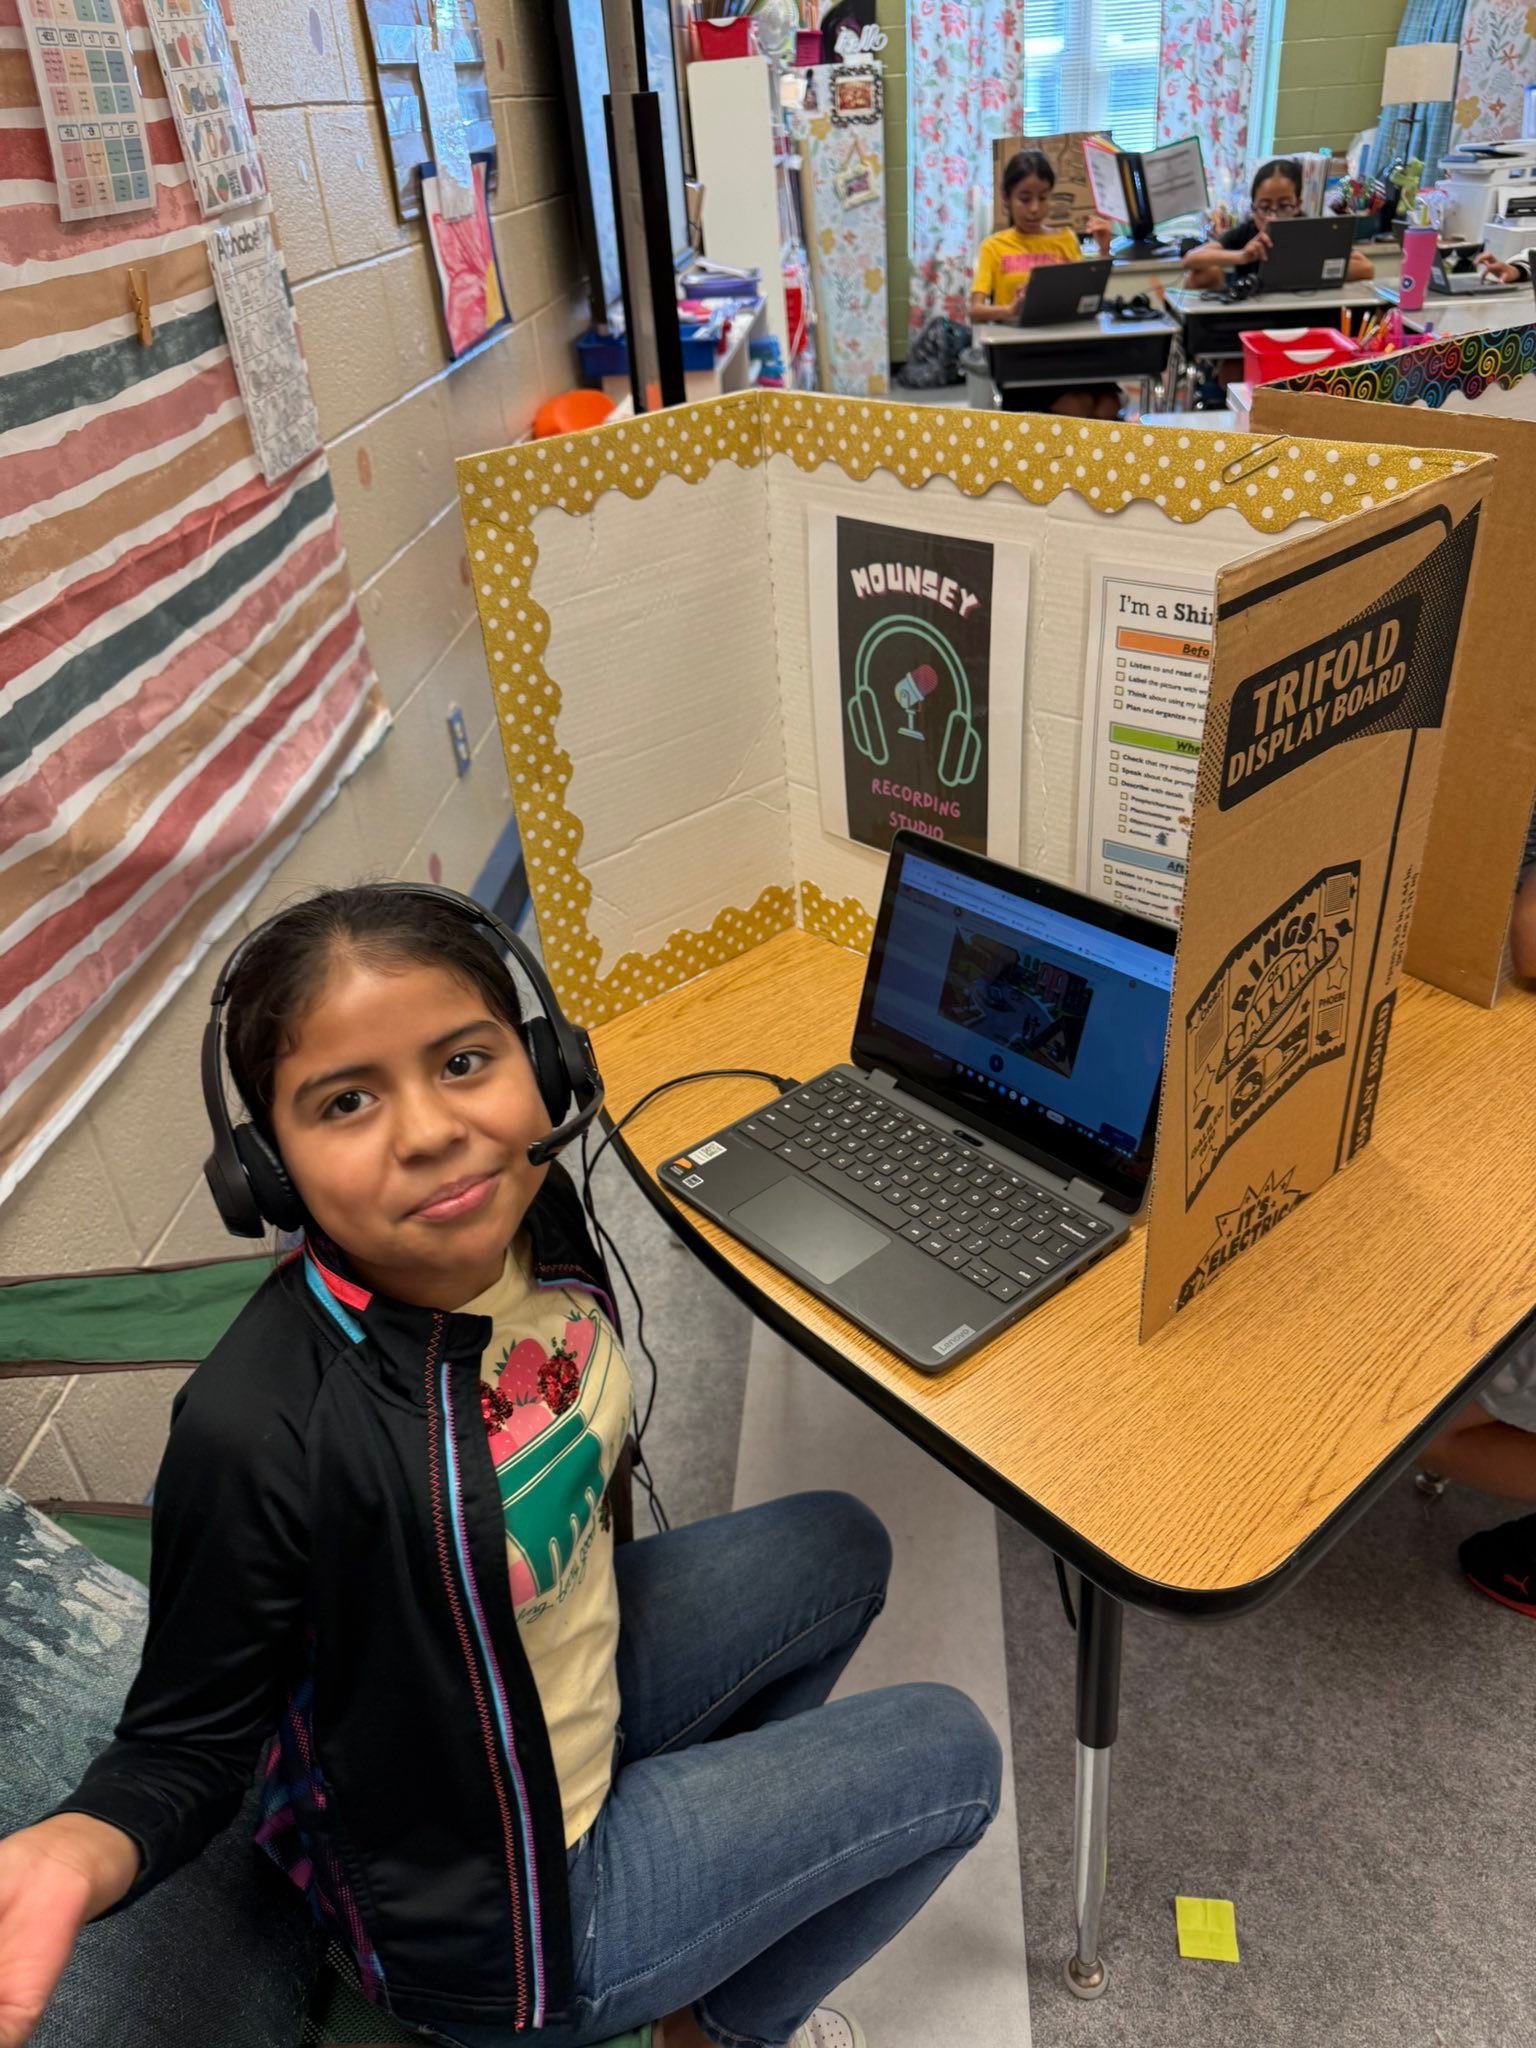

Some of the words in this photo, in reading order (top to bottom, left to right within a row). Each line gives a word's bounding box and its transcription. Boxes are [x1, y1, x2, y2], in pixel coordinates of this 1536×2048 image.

[834, 24, 888, 51] hello
[850, 562, 979, 618] MOUNSEY
[1119, 594, 1150, 616] I'm
[1156, 605, 1168, 619] a
[1129, 661, 1151, 670] Listen
[1175, 669, 1192, 677] read
[1252, 618, 1400, 737] TRIFOLD
[1128, 675, 1147, 684] Label
[1160, 682, 1181, 691] picture
[1127, 689, 1147, 699] Think
[1168, 698, 1184, 708] using
[1126, 703, 1141, 712] Plan
[1155, 710, 1186, 720] organize
[1226, 707, 1331, 788] DISPLAY
[1330, 661, 1406, 727] BOARD
[1122, 754, 1143, 763] Check
[1145, 758, 1157, 767] that
[1121, 767, 1142, 776] Speak
[1143, 772, 1161, 781] about
[871, 778, 961, 818] RECORDING
[889, 811, 944, 840] STUDIO
[1115, 868, 1135, 878] Listen
[1231, 912, 1317, 1013] RINGS
[1267, 964, 1280, 983] OF
[1226, 928, 1326, 1064] SATURN
[1318, 990, 1346, 1009] PHOEBE
[1367, 1002, 1390, 1078] BOARD
[1236, 1195, 1271, 1235] IT'S
[938, 1328, 970, 1352] Lenovo
